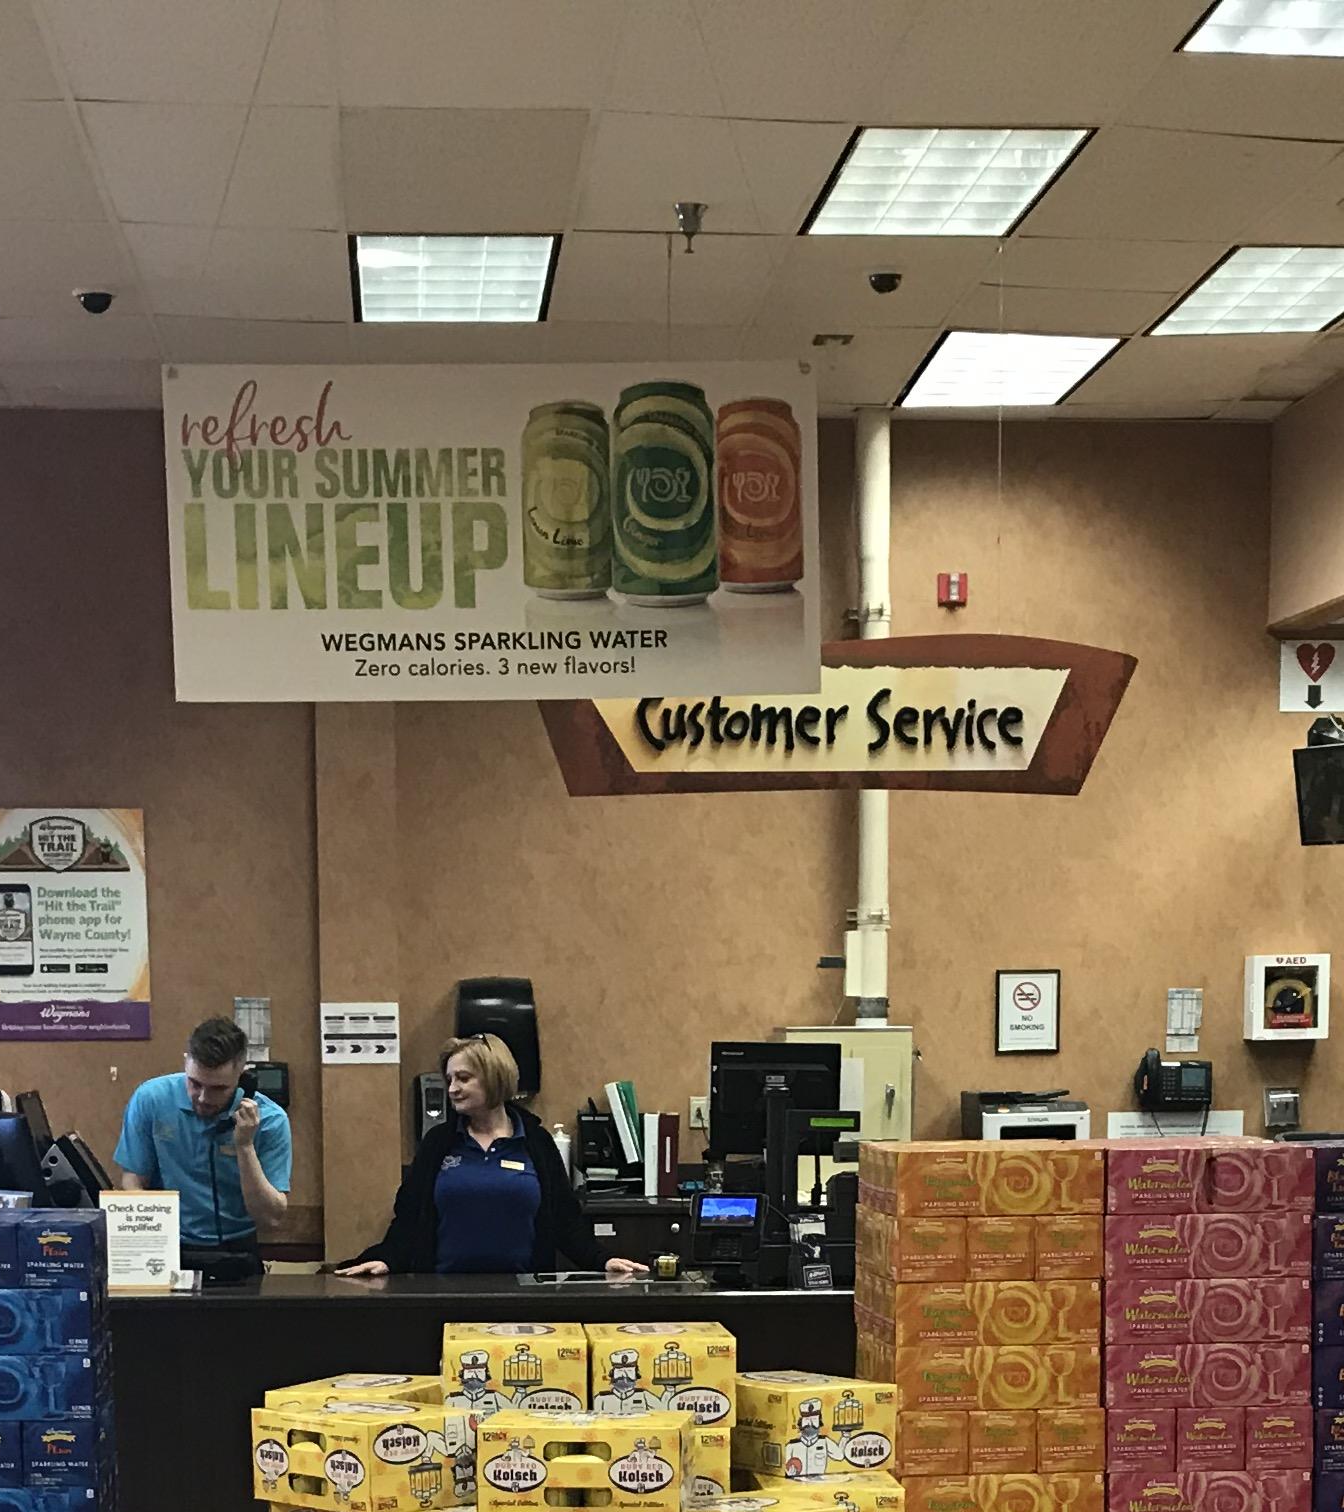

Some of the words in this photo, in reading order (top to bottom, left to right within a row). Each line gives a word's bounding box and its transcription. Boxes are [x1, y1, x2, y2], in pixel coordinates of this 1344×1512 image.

[181, 380, 352, 470] refresh
[182, 449, 299, 500] YOUR
[315, 446, 507, 499] SUMMER
[184, 502, 510, 611] LINEUP
[321, 632, 447, 654] WEGMANS
[454, 630, 584, 652] SPARKLING
[588, 629, 669, 651] WATER
[354, 659, 400, 679] Zero
[407, 656, 492, 678] calories.
[497, 658, 511, 677] 3
[515, 661, 559, 676] new
[562, 656, 637, 675] flavors!
[635, 696, 850, 752] Customer
[866, 687, 1025, 753] Service
[57, 834, 77, 843] THE
[38, 842, 77, 852] TRAIL
[37, 886, 98, 899] Download
[101, 886, 121, 898] the
[66, 901, 87, 912] the
[38, 914, 77, 928] phone
[79, 917, 102, 928] app
[104, 914, 122, 925] for
[39, 929, 82, 943] Wayne
[84, 929, 131, 943] County!
[1285, 957, 1307, 965] AED
[39, 1004, 91, 1023] Wegmans
[1021, 1014, 1033, 1022] NO
[1009, 1023, 1045, 1031] SMOKING
[107, 1203, 134, 1213] Check
[137, 1203, 172, 1214] Cashing
[117, 1223, 162, 1232] simplified!
[849, 1443, 885, 1458] Kolsch
[491, 1468, 539, 1483] Kolsch
[618, 1469, 665, 1484] Kolsch
